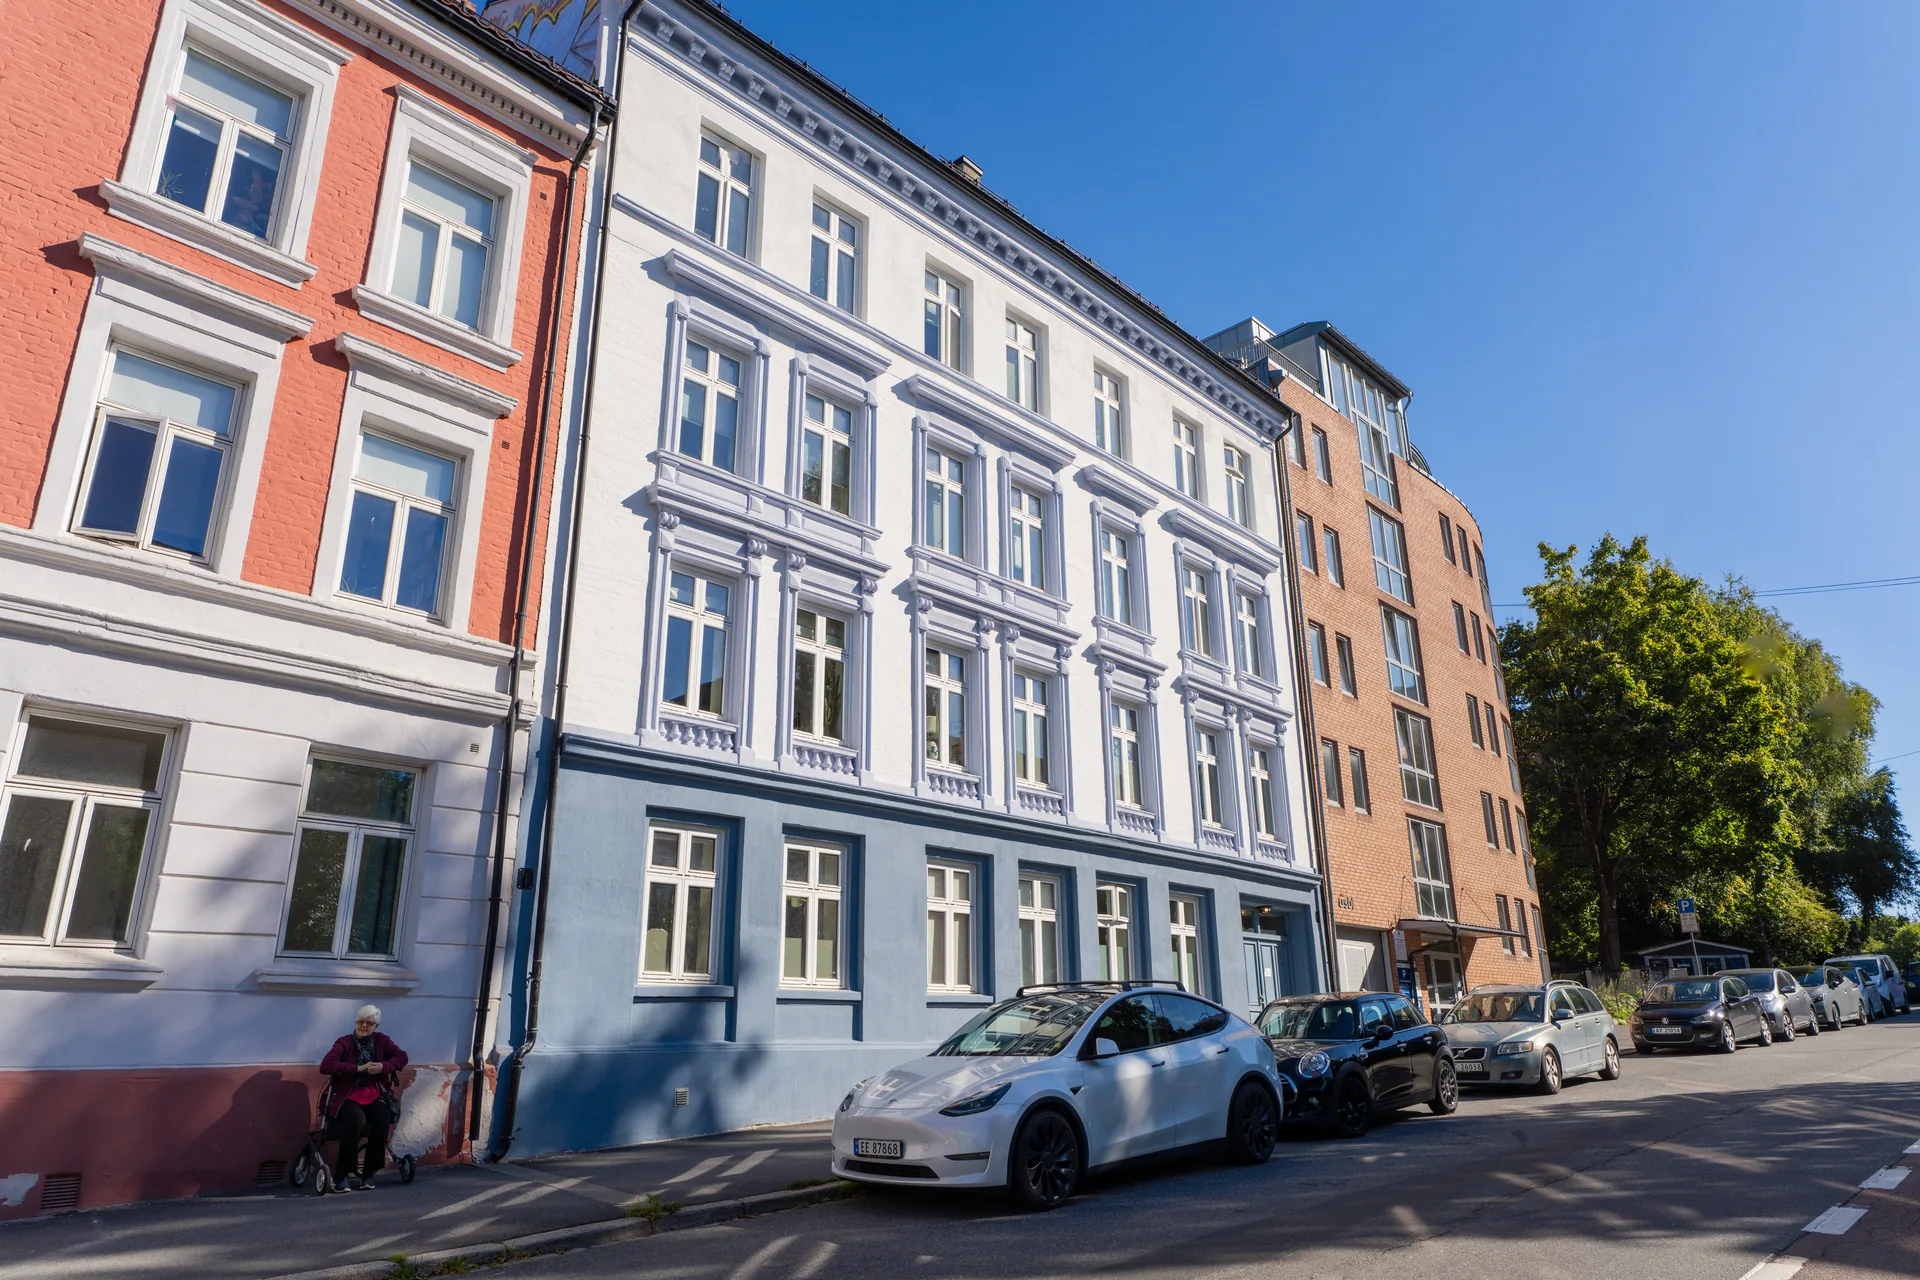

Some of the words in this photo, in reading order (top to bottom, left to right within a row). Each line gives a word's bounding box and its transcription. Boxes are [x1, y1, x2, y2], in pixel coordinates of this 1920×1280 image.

[1681, 901, 1689, 911] P
[1460, 1063, 1481, 1071] 26038
[861, 1141, 869, 1153] EE
[872, 1142, 898, 1155] 87868
